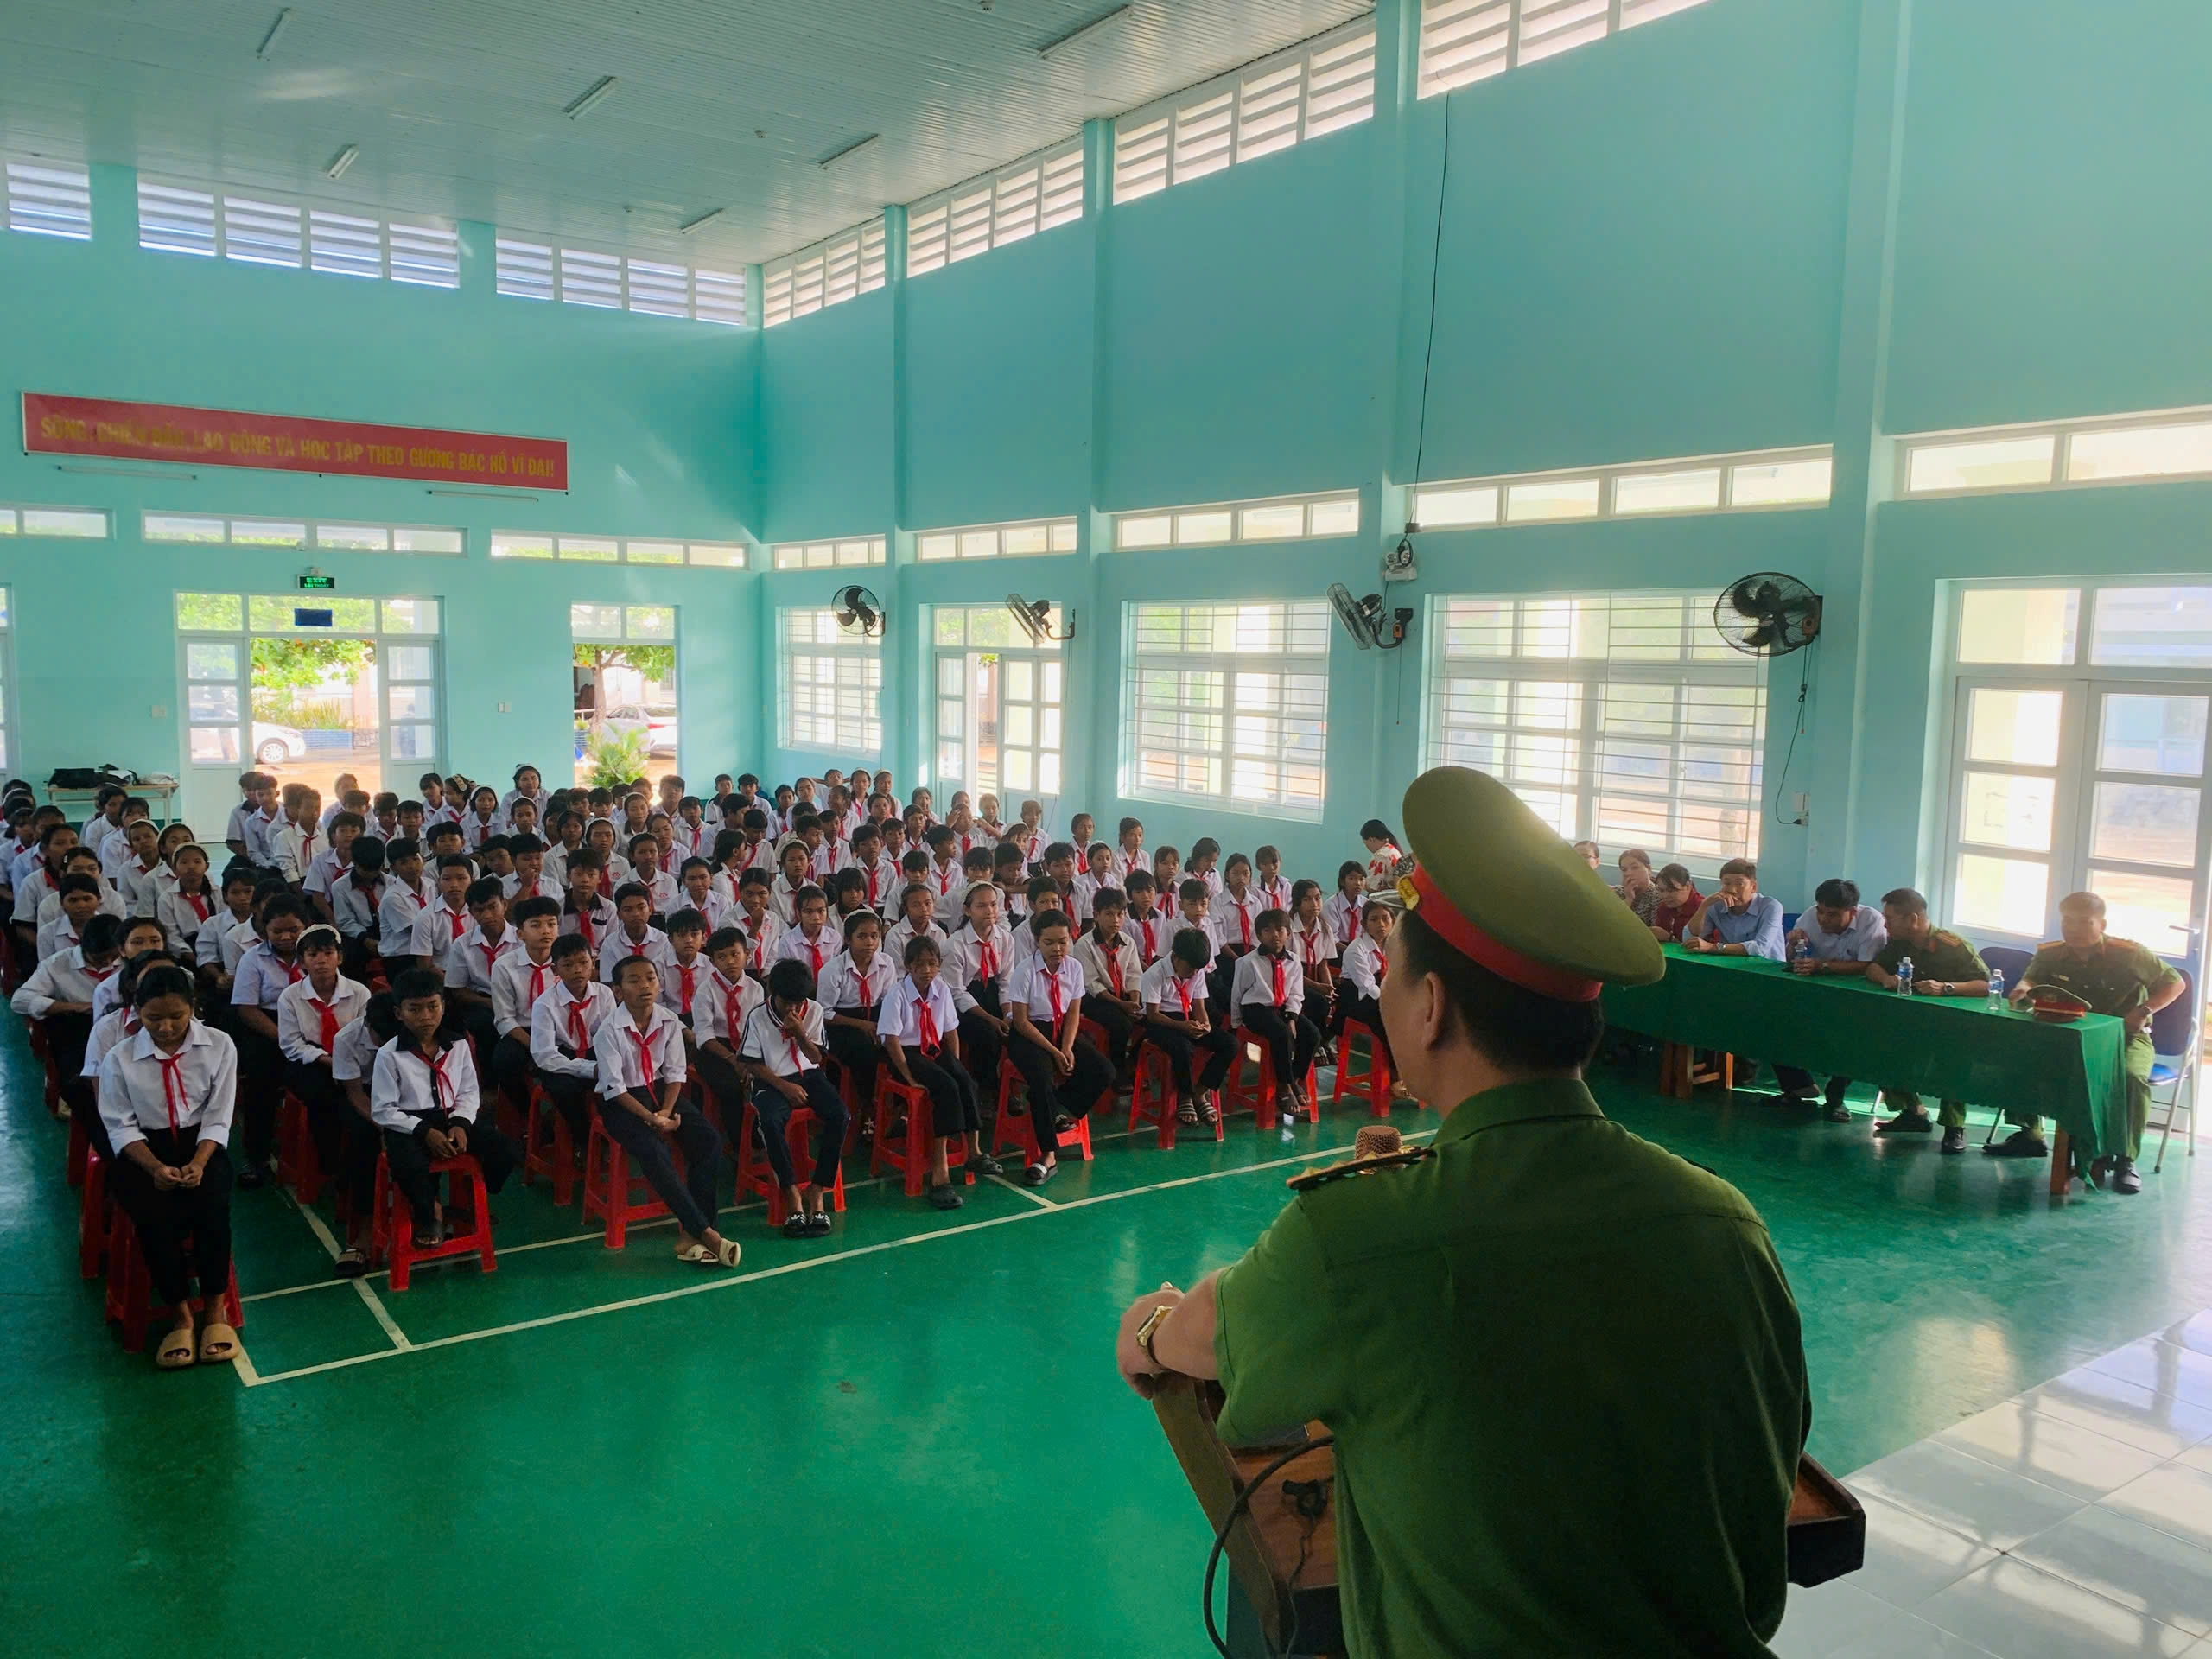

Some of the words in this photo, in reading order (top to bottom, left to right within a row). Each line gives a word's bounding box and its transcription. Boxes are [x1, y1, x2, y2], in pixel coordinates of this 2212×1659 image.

[300, 439, 330, 463] HỌC
[334, 437, 364, 464] TẬP
[367, 443, 404, 465] THEO
[458, 449, 485, 472] BÁC
